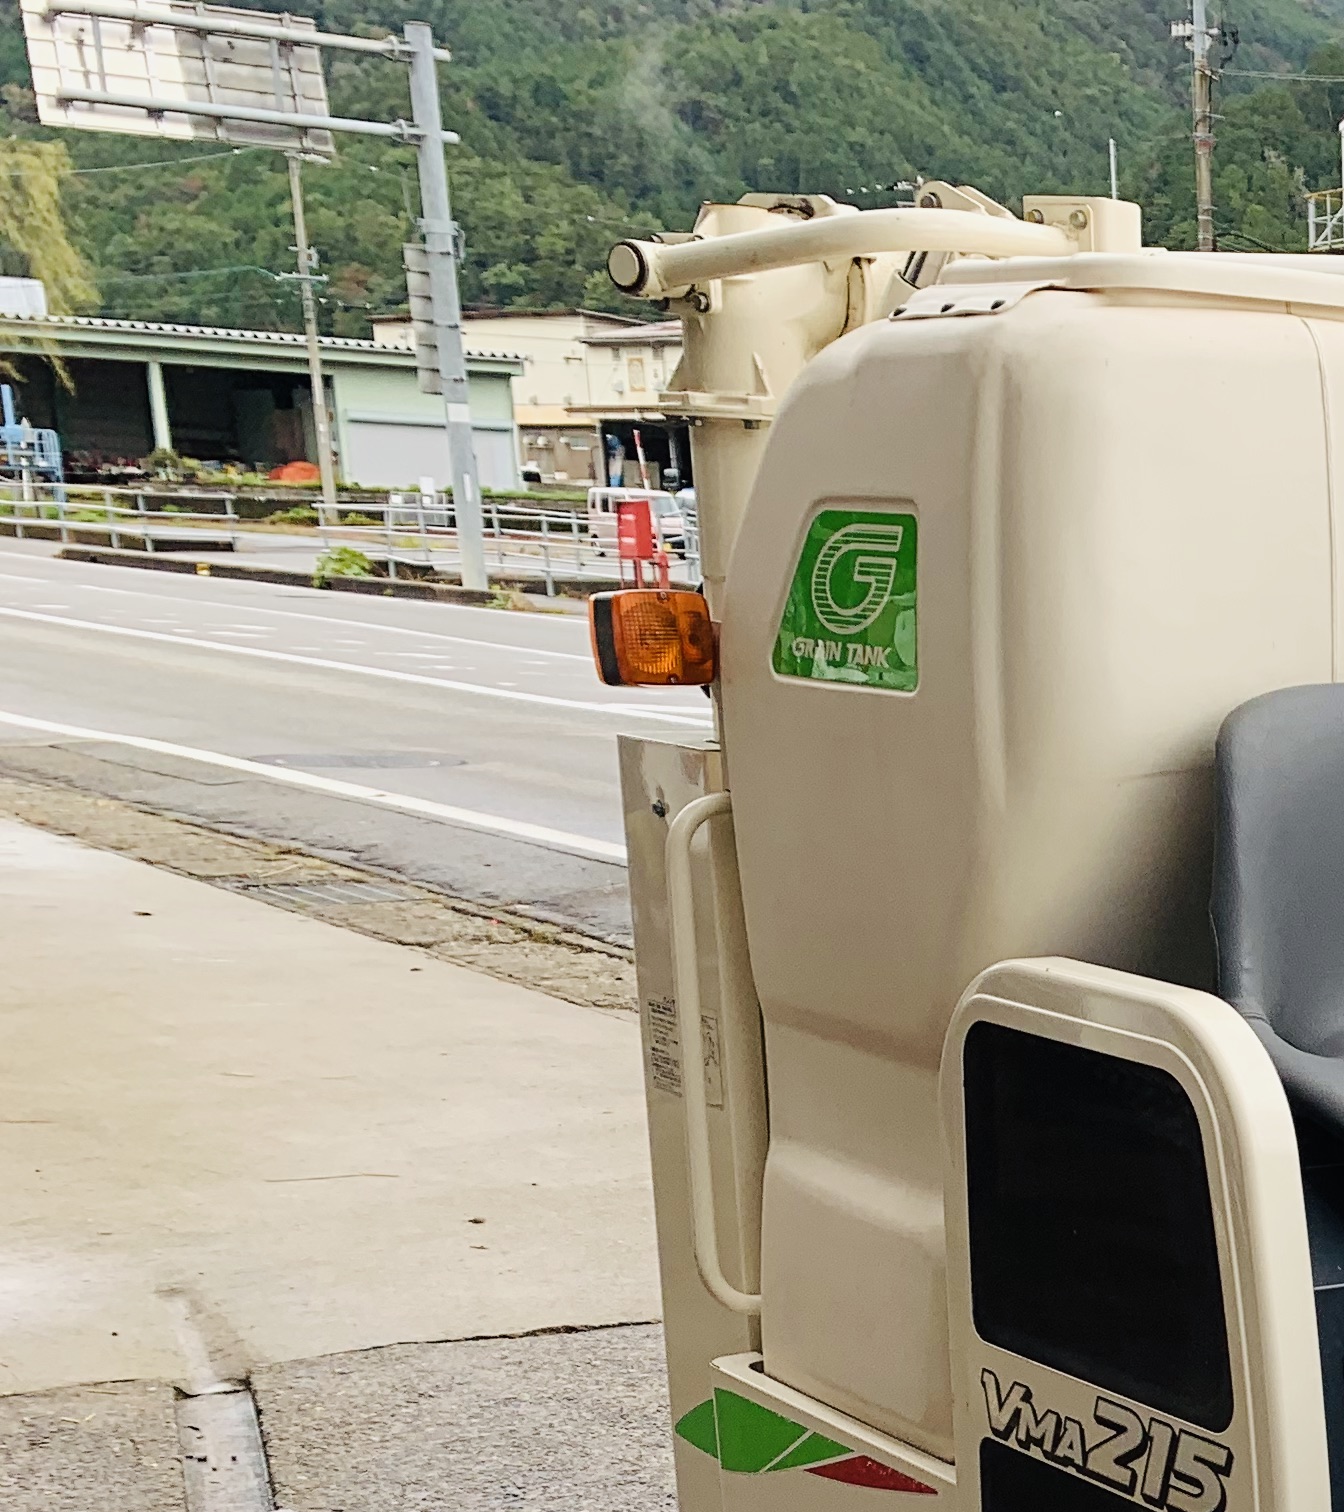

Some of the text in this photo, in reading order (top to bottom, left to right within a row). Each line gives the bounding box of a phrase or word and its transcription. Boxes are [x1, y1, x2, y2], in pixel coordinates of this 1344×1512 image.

[811, 523, 903, 635] G
[792, 637, 892, 668] GRAIN TANK
